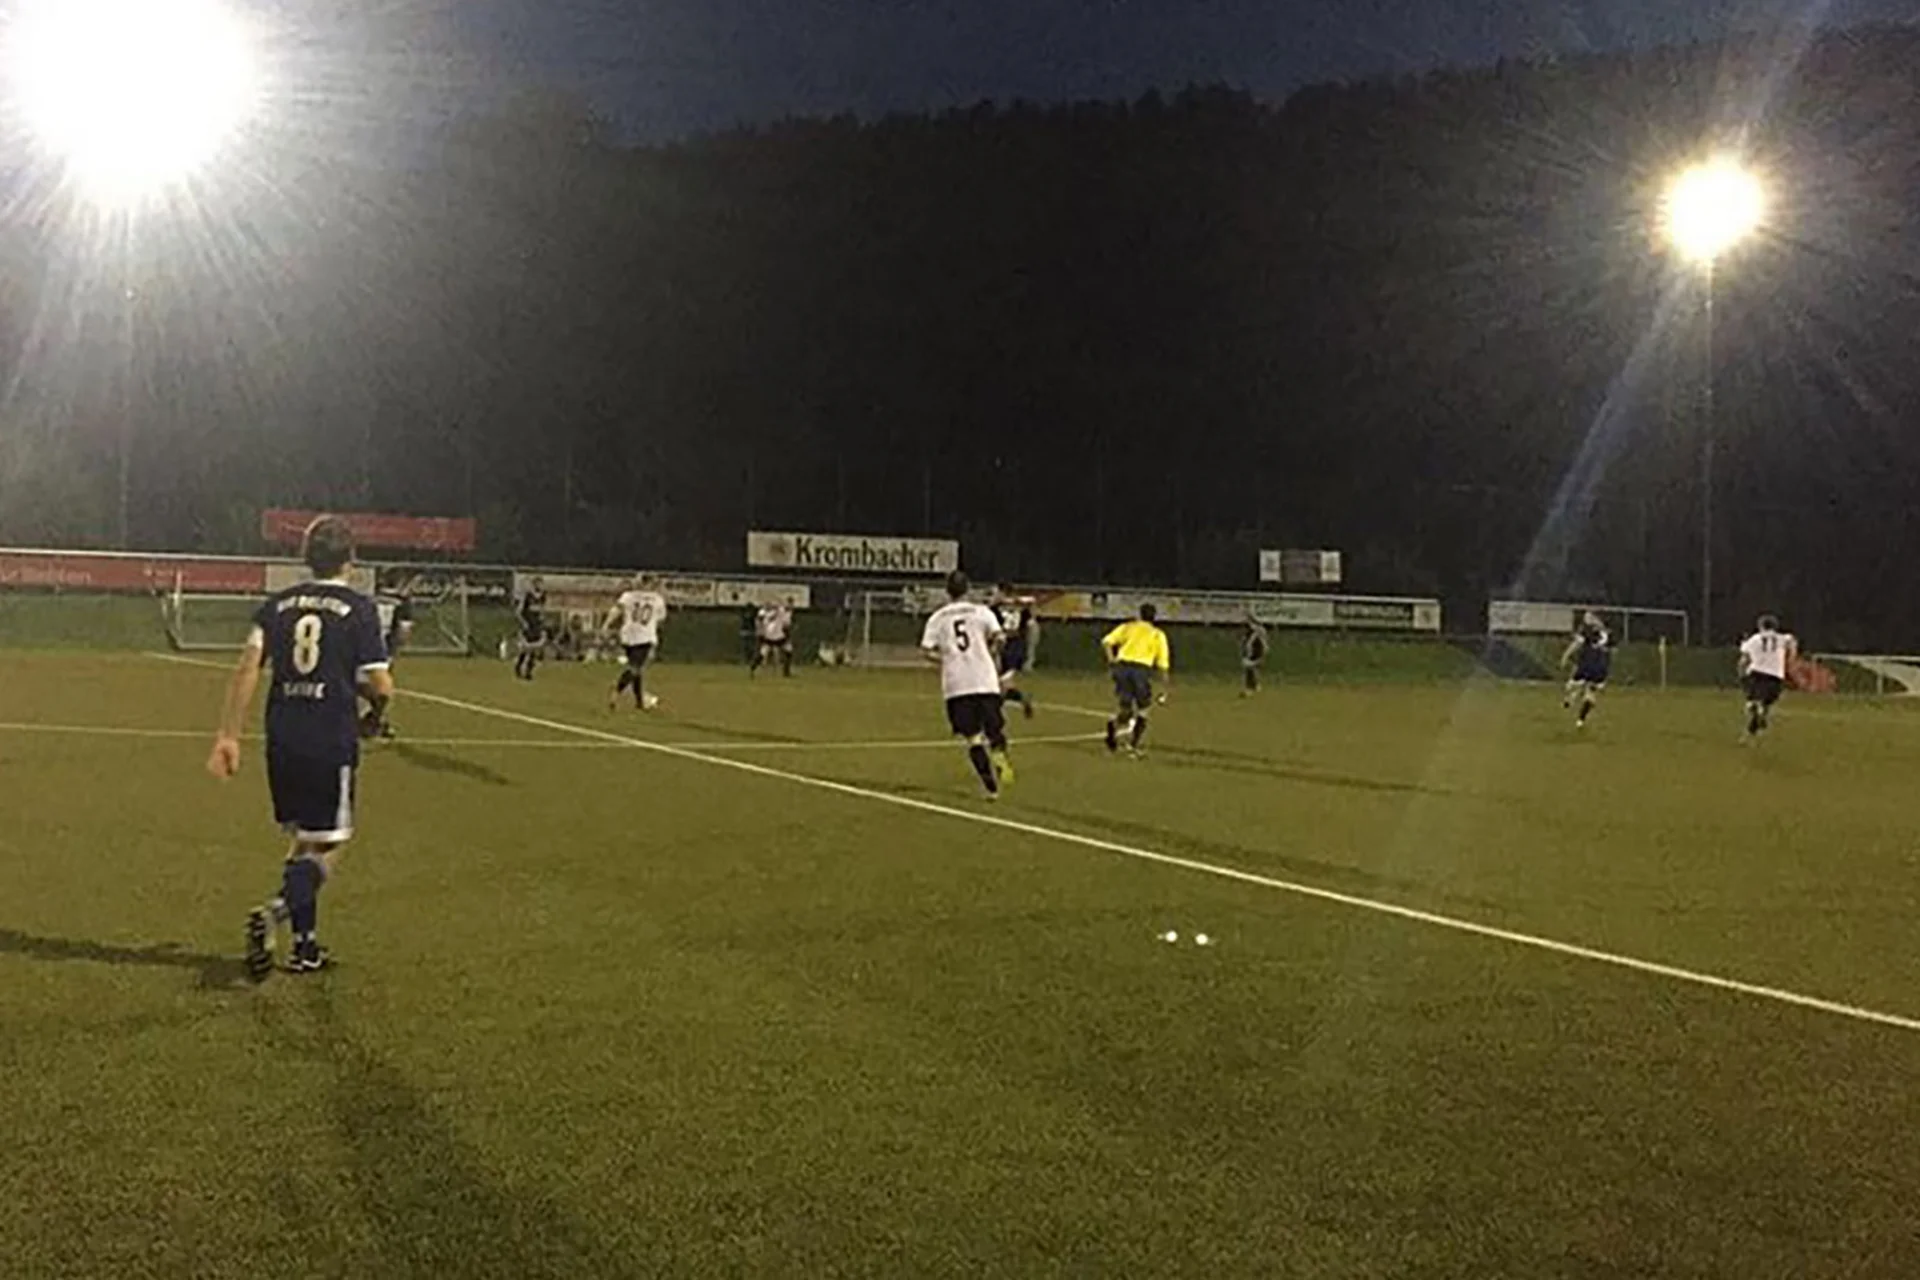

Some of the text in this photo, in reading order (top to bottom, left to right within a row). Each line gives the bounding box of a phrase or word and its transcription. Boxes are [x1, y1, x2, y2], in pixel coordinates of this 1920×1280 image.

[796, 537, 939, 569] Krombacher
[631, 602, 653, 625] 10
[293, 614, 322, 674] 8
[953, 619, 970, 652] 5
[1761, 636, 1778, 652] 11
